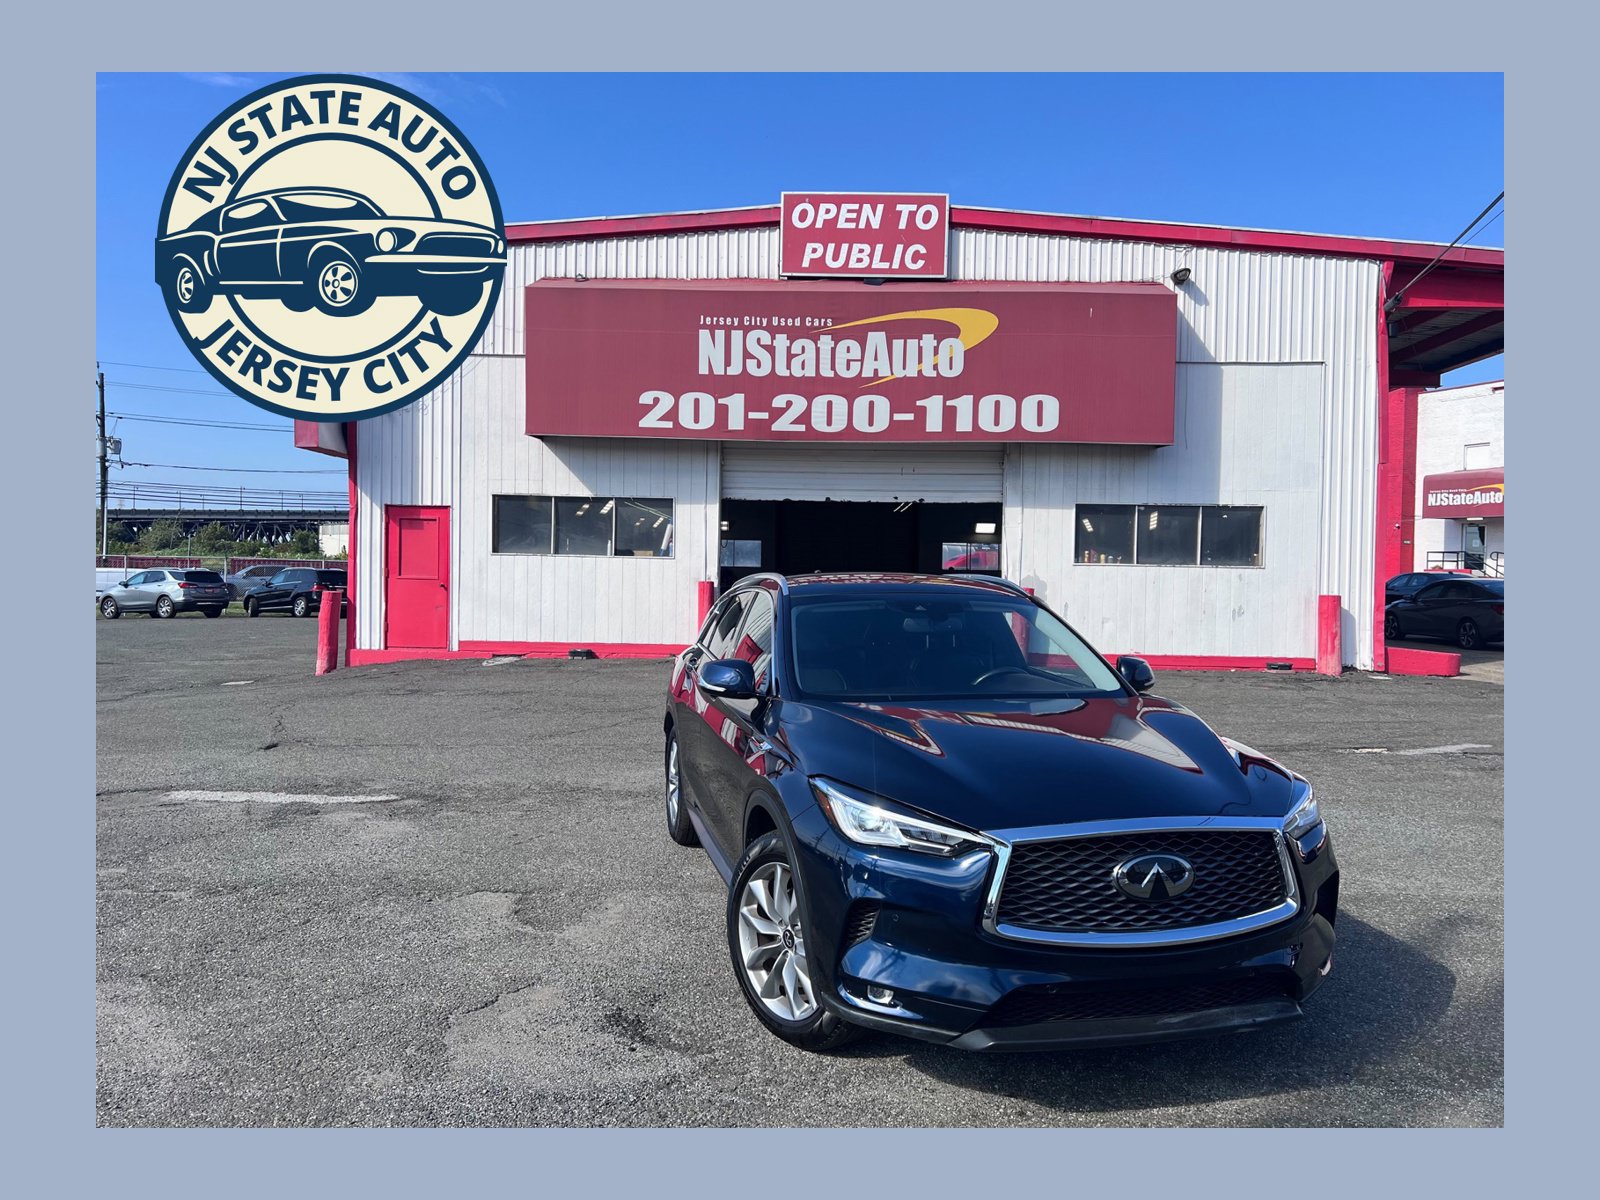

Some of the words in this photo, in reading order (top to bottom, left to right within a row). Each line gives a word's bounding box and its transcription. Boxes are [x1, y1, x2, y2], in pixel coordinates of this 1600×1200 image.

[791, 202, 884, 229] OPEN
[895, 204, 939, 230] TO
[801, 242, 927, 270] PUBLIC
[699, 315, 739, 326] Jersey
[743, 316, 768, 327] City
[772, 316, 801, 326] Used
[805, 317, 833, 327] Cars
[698, 329, 965, 378] NJStateAuto
[638, 390, 1060, 433] 201-200-1100
[1427, 491, 1504, 506] NJStateAuto
